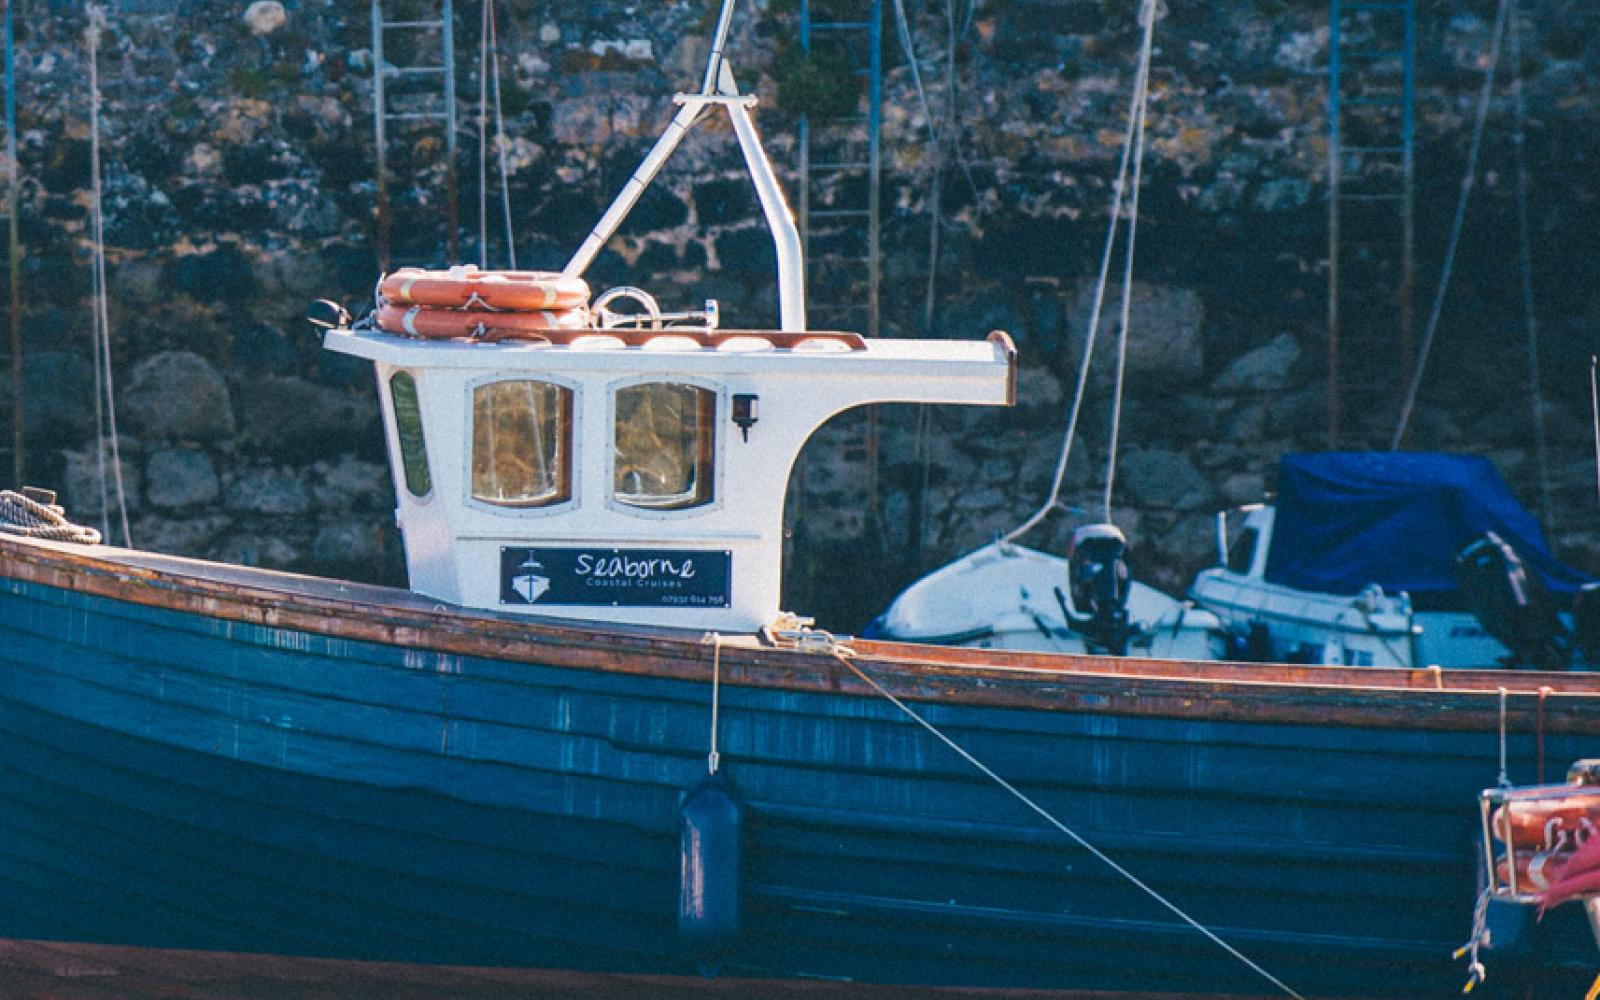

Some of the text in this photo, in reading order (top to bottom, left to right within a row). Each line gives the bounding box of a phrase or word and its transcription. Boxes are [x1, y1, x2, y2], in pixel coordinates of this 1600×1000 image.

[575, 554, 696, 579] Seaborne
[586, 578, 681, 588] Coastal Cruises
